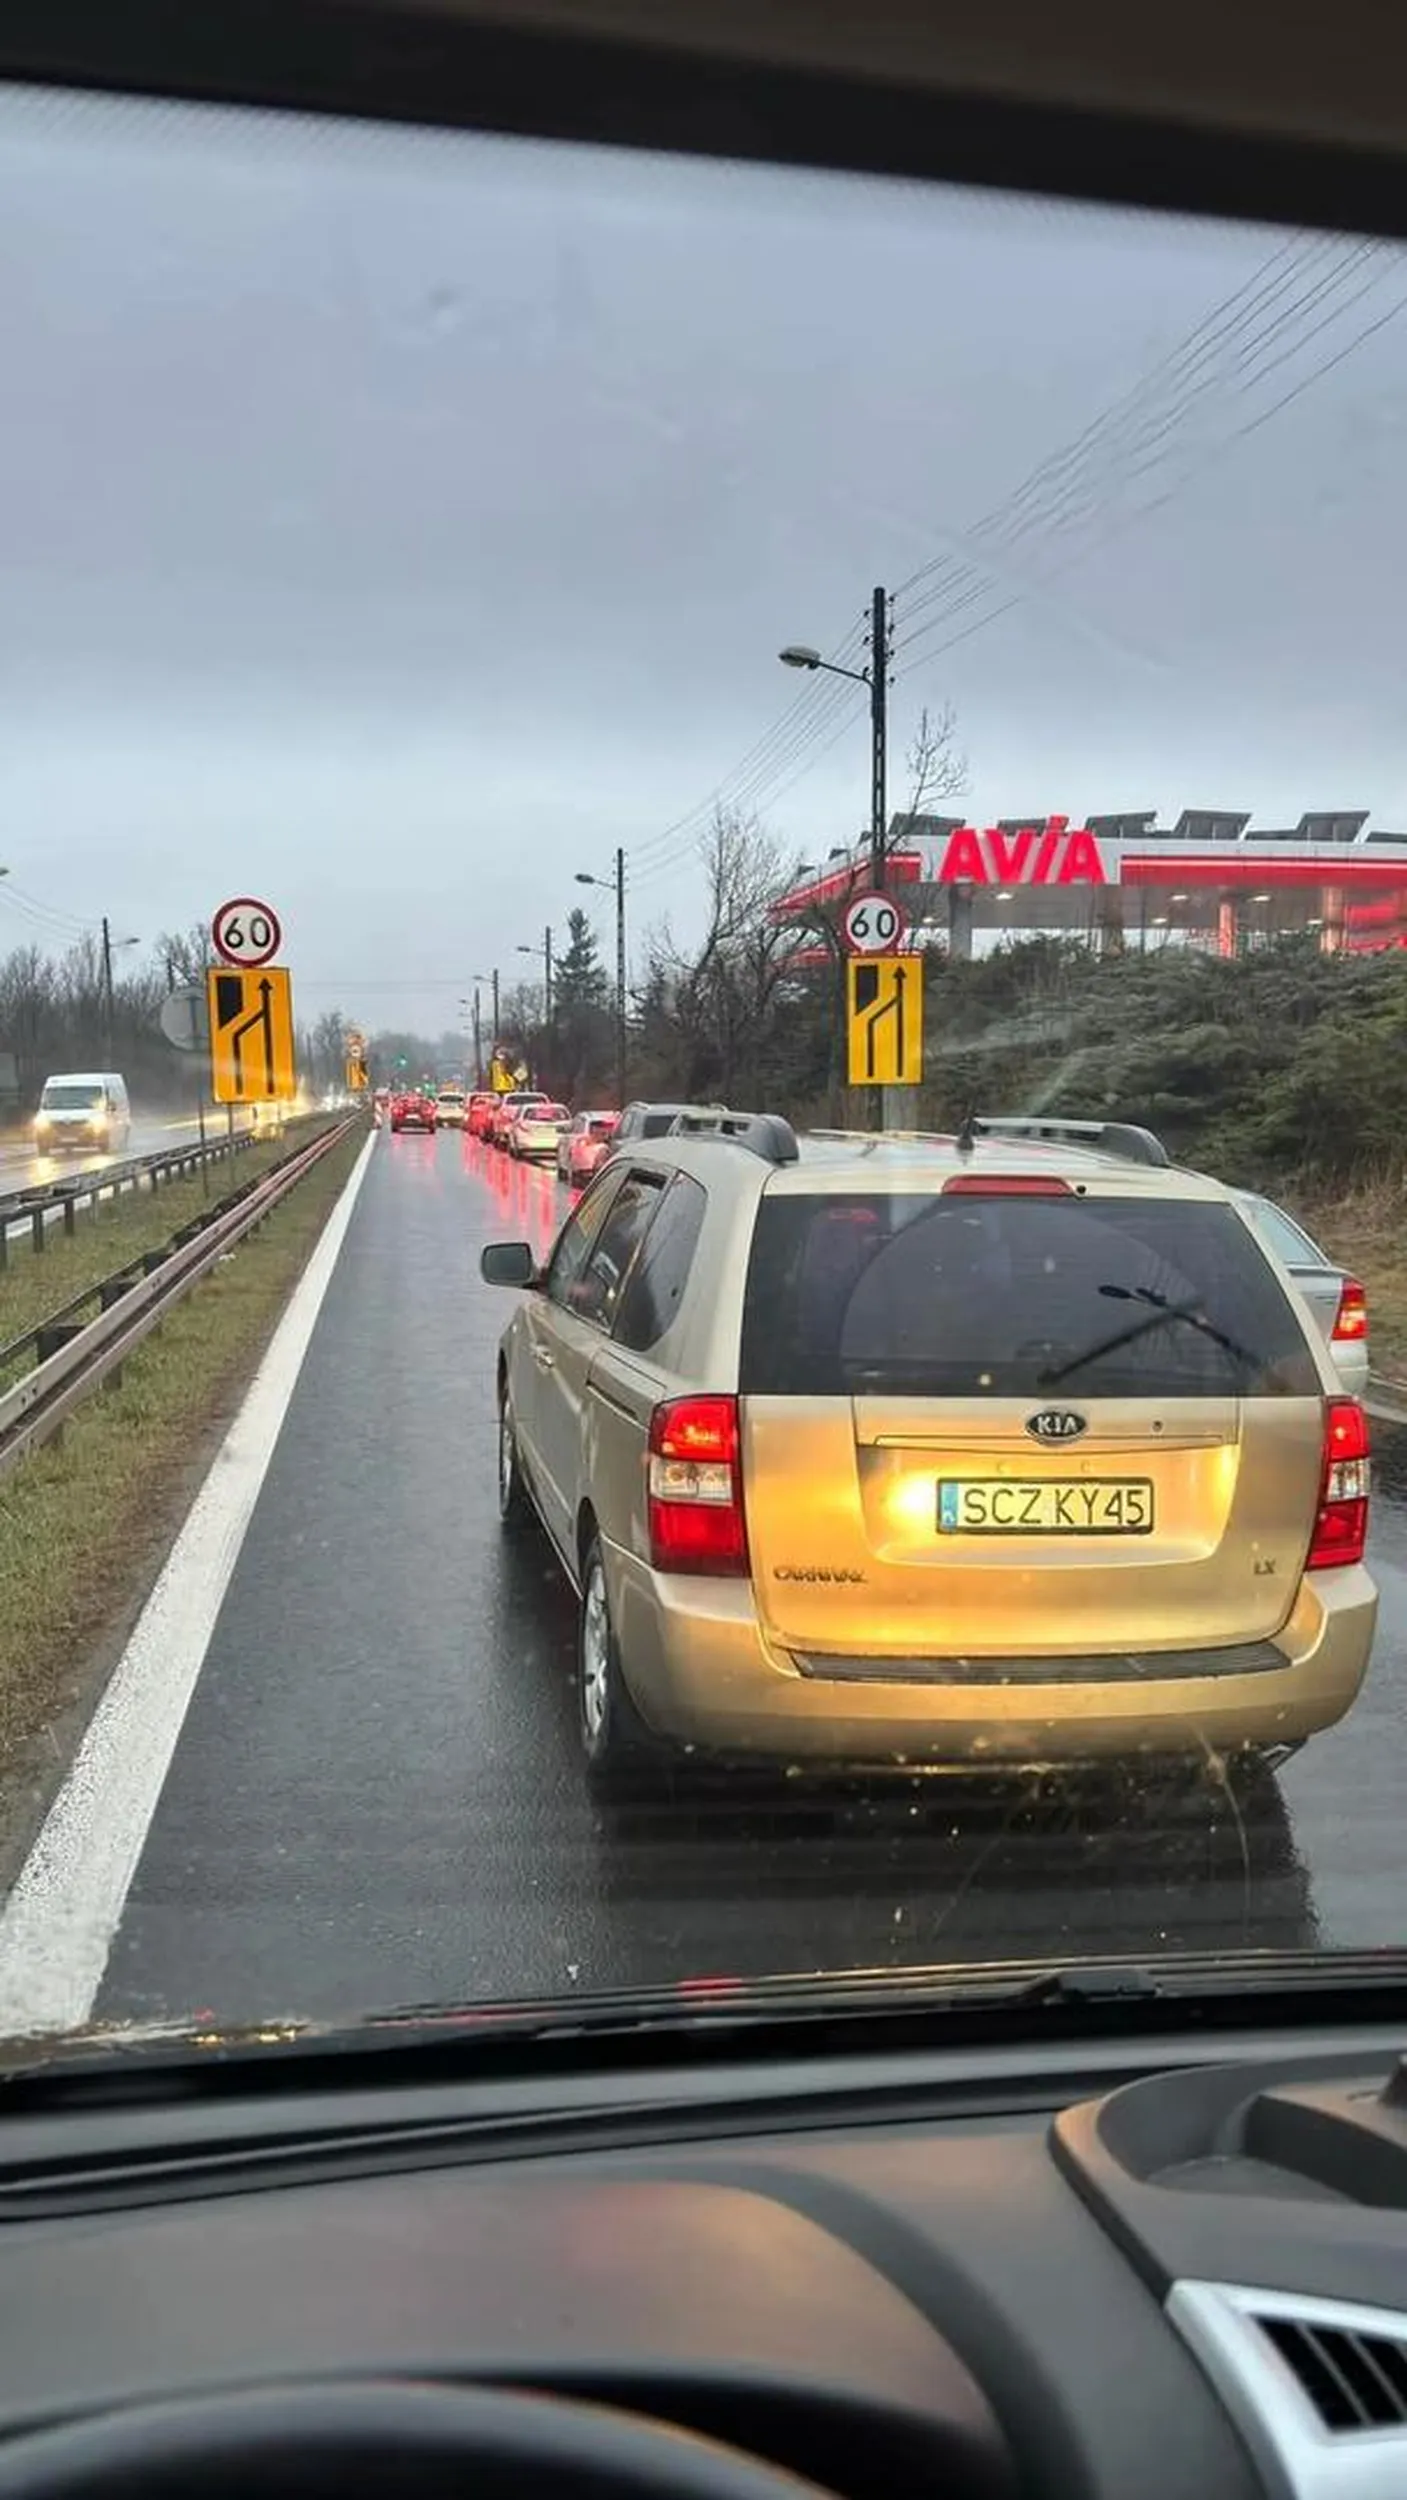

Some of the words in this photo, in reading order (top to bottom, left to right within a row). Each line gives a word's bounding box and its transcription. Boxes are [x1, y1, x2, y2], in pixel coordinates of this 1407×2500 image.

[224, 916, 271, 949] 60
[851, 907, 896, 939] 60
[1037, 1415, 1078, 1434] KIA
[964, 1488, 1042, 1525] SCZ
[1055, 1488, 1144, 1525] KY45
